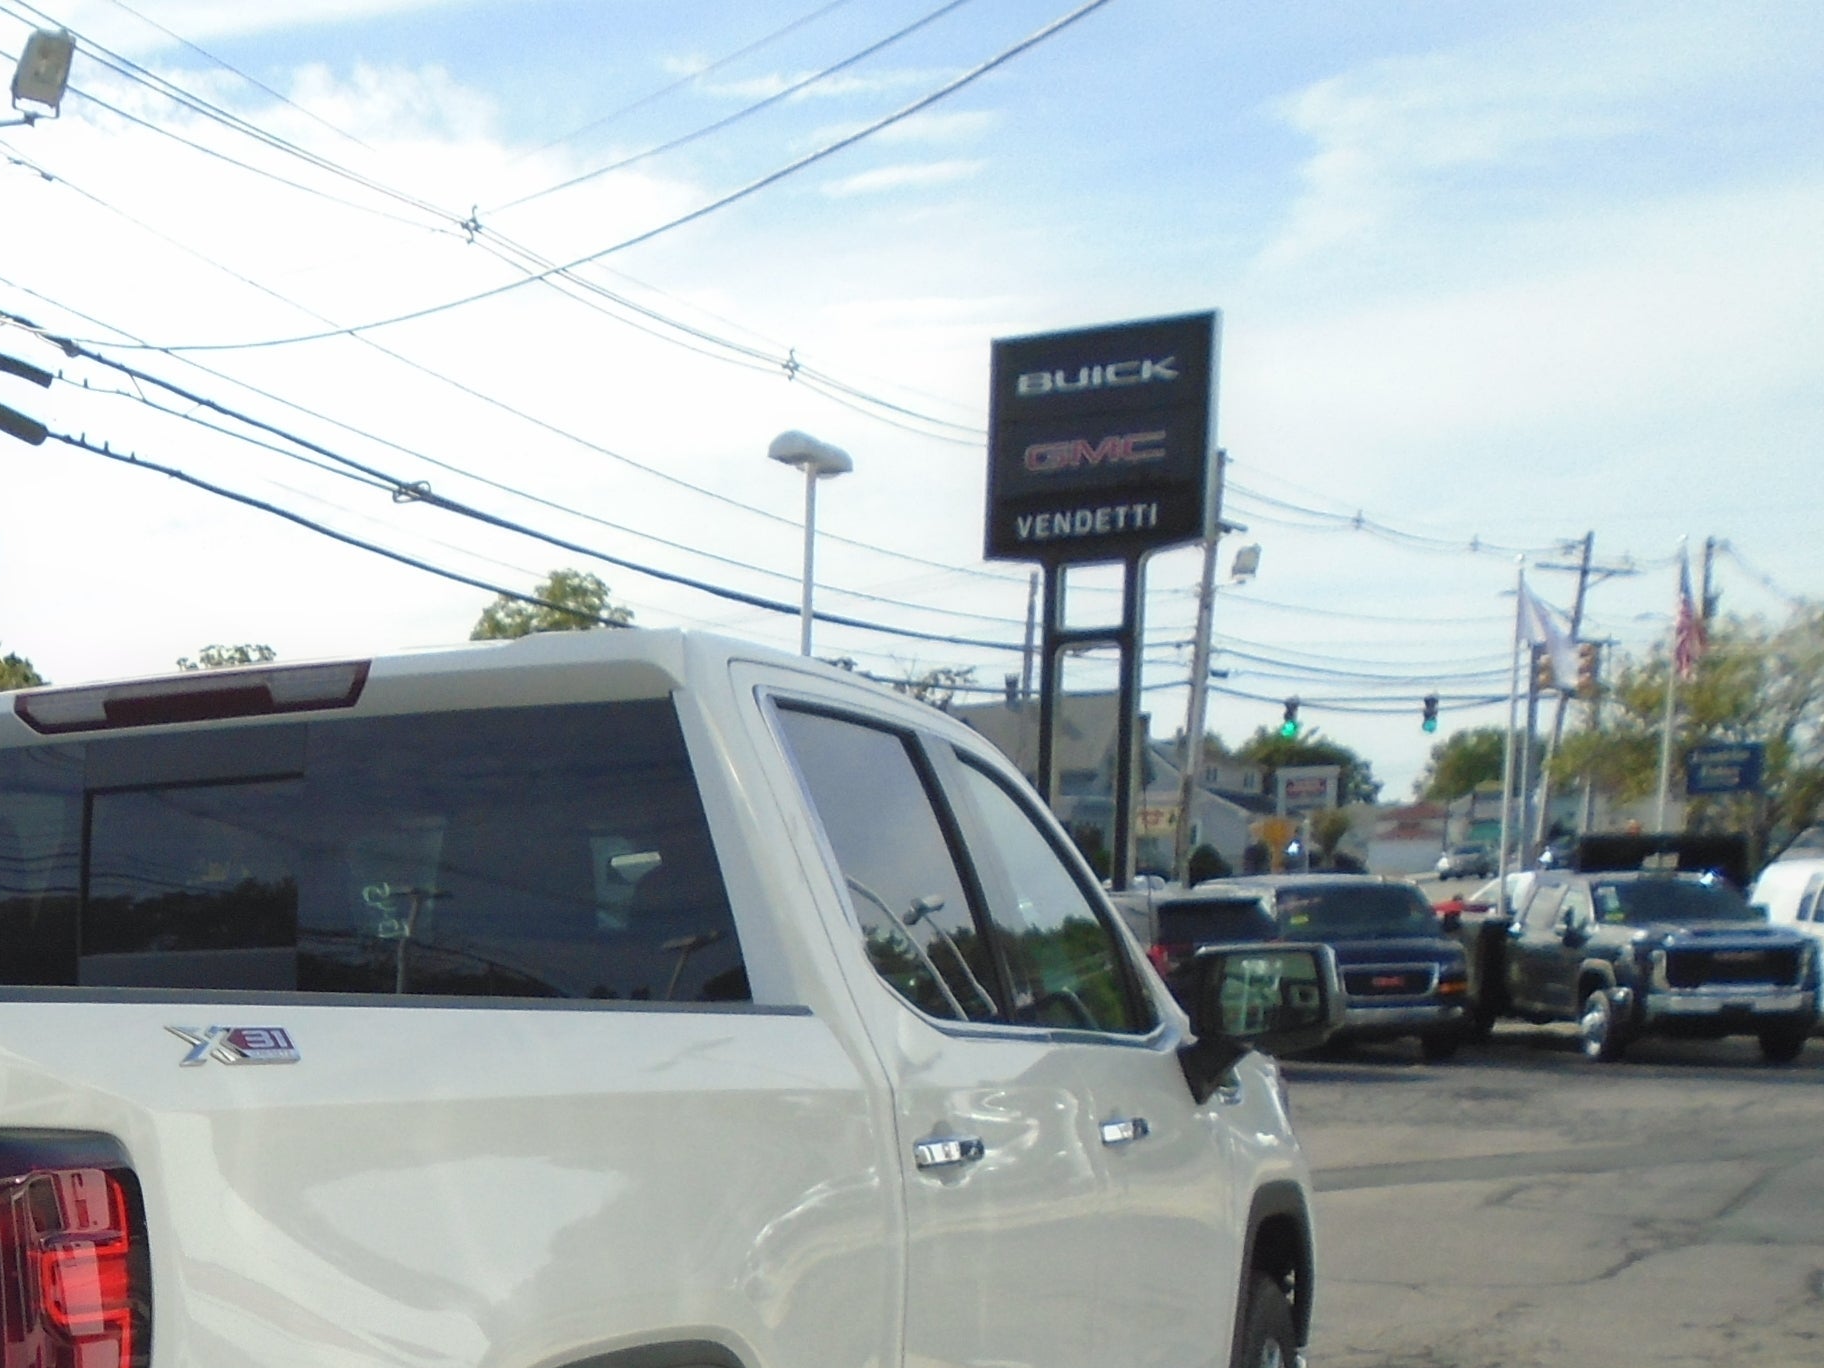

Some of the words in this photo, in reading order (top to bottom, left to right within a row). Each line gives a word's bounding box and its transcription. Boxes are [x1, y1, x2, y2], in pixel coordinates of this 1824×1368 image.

[1016, 356, 1179, 396] BUICK
[1024, 430, 1166, 471] GMC
[1016, 503, 1158, 538] VENDETTI
